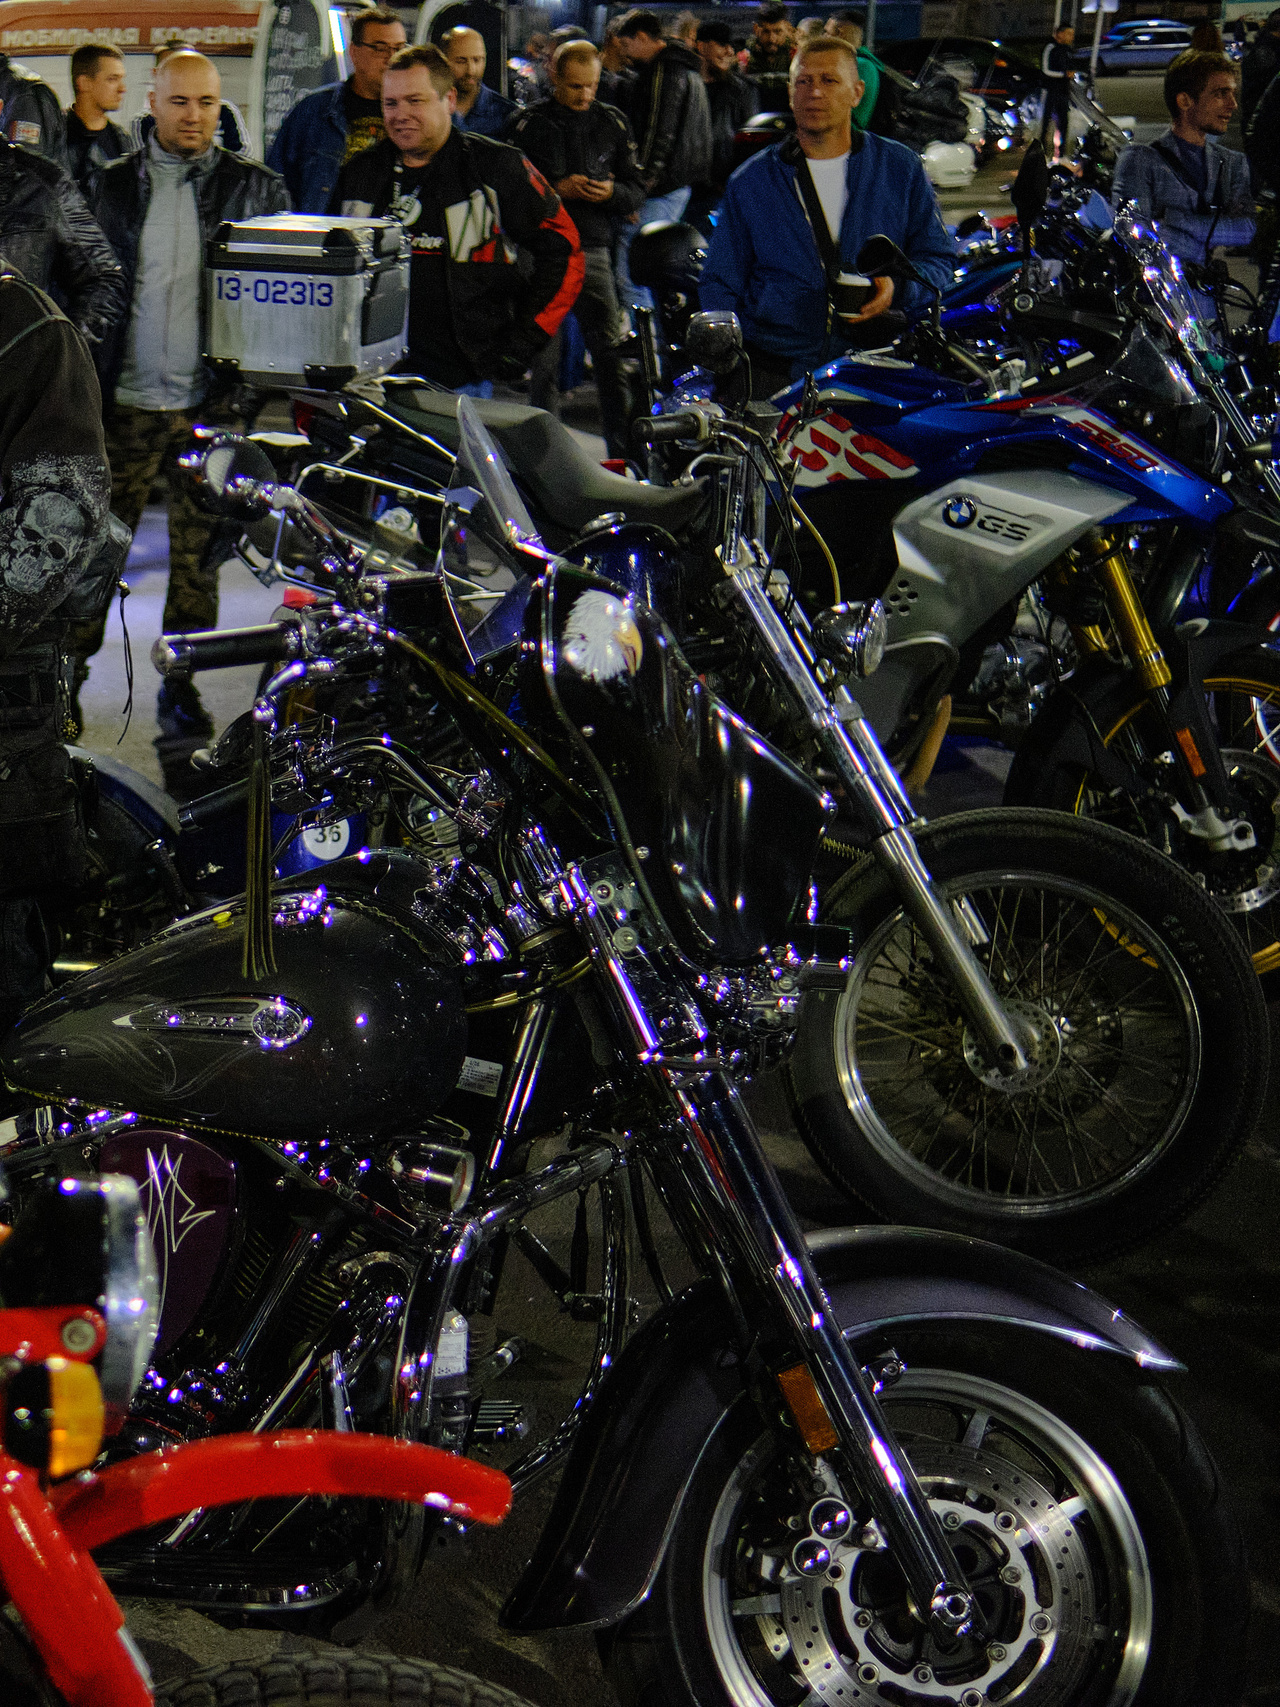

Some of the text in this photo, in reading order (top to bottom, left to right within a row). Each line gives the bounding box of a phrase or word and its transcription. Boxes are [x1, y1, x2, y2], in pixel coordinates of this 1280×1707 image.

[1, 28, 140, 47] МОБИЛЬНАЯ
[217, 276, 334, 307] 13-02313
[977, 514, 1032, 541] GS
[314, 825, 341, 843] 36
